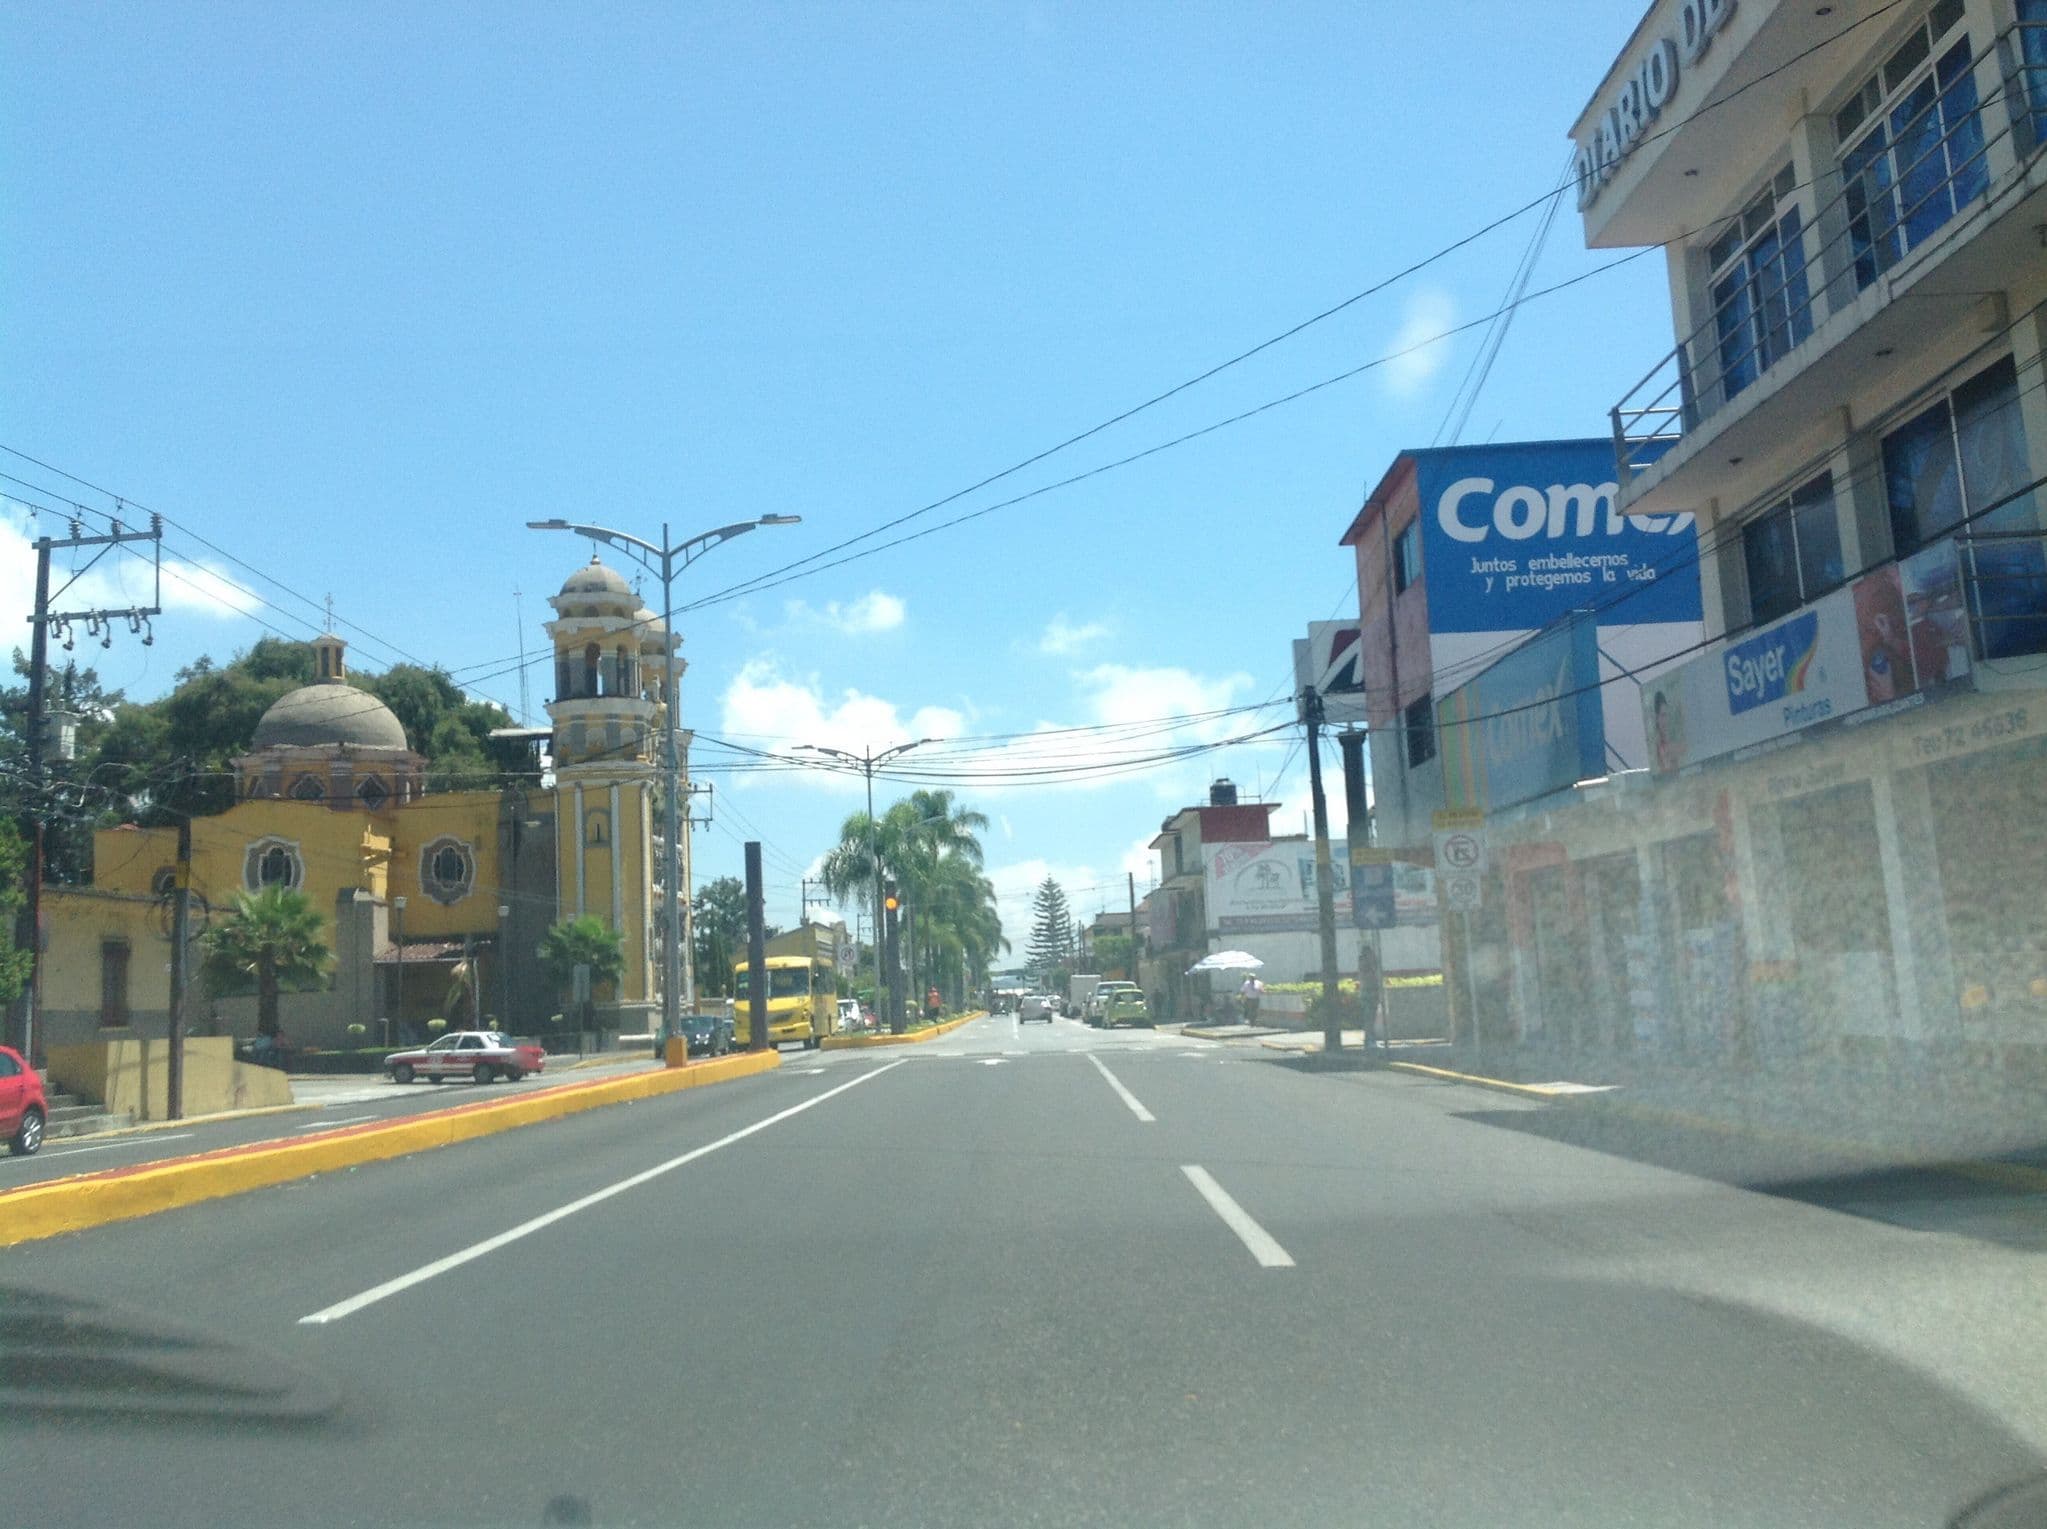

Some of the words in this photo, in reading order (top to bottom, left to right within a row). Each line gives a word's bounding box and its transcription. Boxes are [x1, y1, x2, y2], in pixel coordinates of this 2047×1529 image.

[1576, 38, 1678, 212] DIARIO
[1437, 477, 1695, 542] Com
[1471, 557, 1517, 573] Juntos
[1528, 553, 1629, 570] embellecemos
[1485, 576, 1494, 593] y
[1506, 571, 1591, 592] protegemos
[1602, 567, 1616, 582] la
[1627, 563, 1656, 581] vida
[1728, 645, 1786, 699] Sayer
